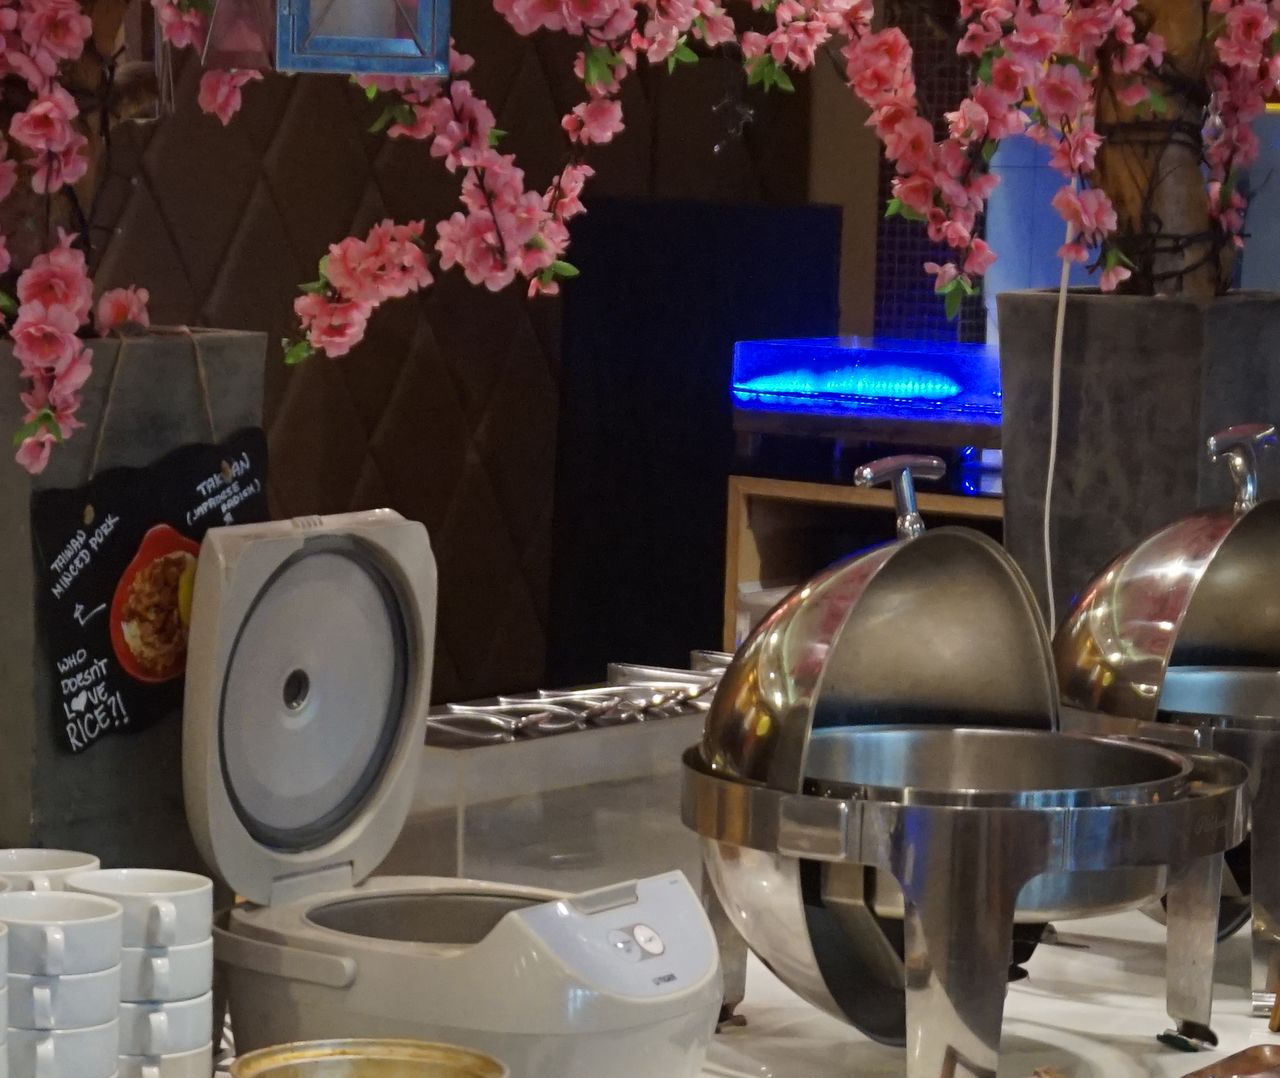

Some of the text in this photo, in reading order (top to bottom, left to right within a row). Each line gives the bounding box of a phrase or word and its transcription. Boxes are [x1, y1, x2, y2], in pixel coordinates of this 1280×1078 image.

[196, 452, 250, 495] TAKAN
[51, 513, 120, 600] MINCED PORK
[56, 648, 87, 674] WHO
